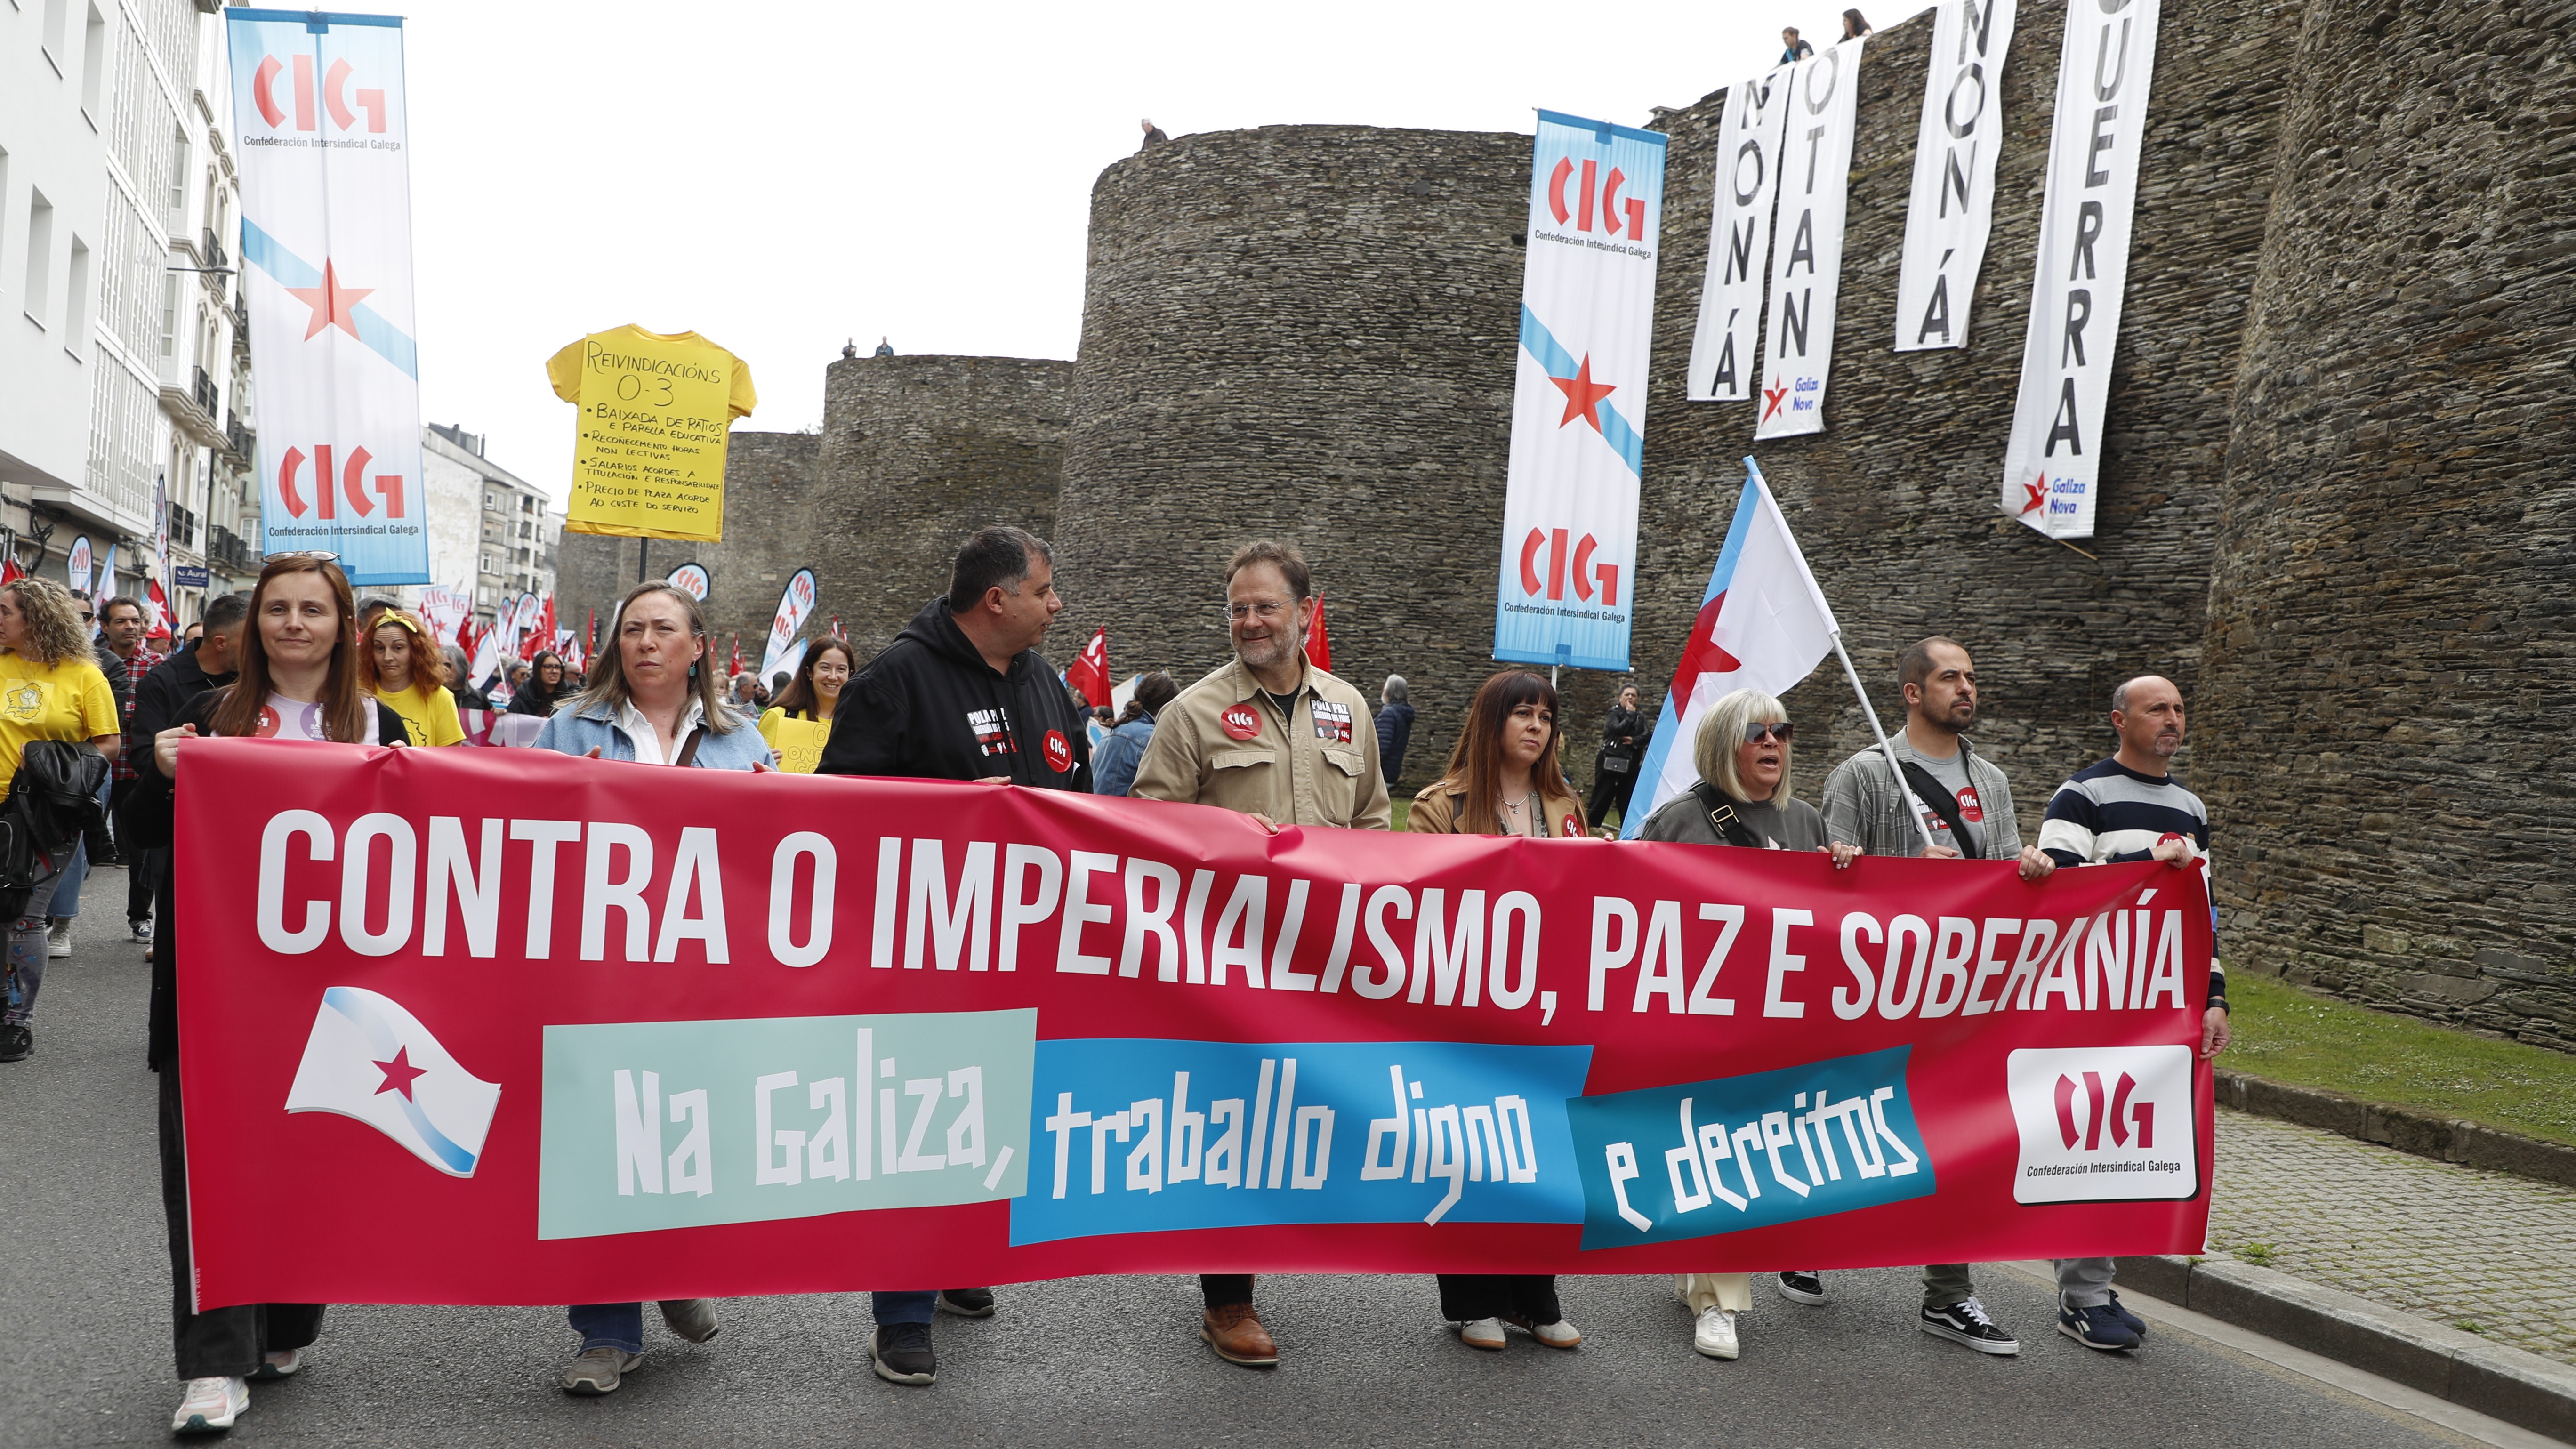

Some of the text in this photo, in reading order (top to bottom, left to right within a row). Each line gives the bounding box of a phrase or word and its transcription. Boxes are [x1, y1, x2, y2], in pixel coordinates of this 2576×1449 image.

[254, 54, 386, 133] CIG
[1939, 0, 1994, 219] NON
[244, 136, 400, 151] Confederación Intersindical Galega
[1724, 73, 1777, 285] NON
[1549, 156, 1645, 242] CIG
[1779, 47, 1839, 359] OTAN
[1535, 229, 1584, 246] Confederación
[1628, 246, 1651, 260] Galega
[1917, 249, 1955, 344] Á
[587, 341, 720, 384] REIVINDICACIÓNS
[1711, 308, 1740, 396] Á
[1795, 377, 1818, 392] Galiza
[1793, 396, 1813, 411] Nova
[596, 403, 723, 436] BAIXADA DE RATIOS
[591, 430, 701, 454] RECOÑECEMENTO HORAS
[622, 422, 666, 435] PARELLA
[670, 430, 721, 445] EDUCATIVA
[596, 446, 671, 460] NON LECTIVAS
[584, 468, 638, 481] TITULACIÓN
[589, 457, 637, 471] SALARIOS
[642, 465, 680, 476] ACORDES
[279, 445, 405, 520] CIG
[585, 481, 710, 503] PRECIO DE PLAZA ACORDE
[2053, 477, 2085, 494] Galiza
[589, 498, 604, 507] AO
[610, 499, 639, 508] CUSTE
[646, 502, 658, 510] DO
[2049, 497, 2077, 514] Nova
[269, 525, 419, 536] Confederación Intersindical Galega
[187, 569, 207, 578] Aural
[1520, 527, 1618, 606] CIG
[678, 569, 703, 595] CIG
[796, 575, 812, 605] CIG
[425, 590, 448, 604] CIG
[452, 598, 465, 611] IG
[1505, 602, 1625, 624] Confederación Intersindical Galega
[775, 614, 791, 641] CIG
[967, 710, 991, 725] POLA
[1311, 699, 1349, 715] POLA PAZ
[1228, 712, 1253, 725] CIG
[1341, 730, 1349, 739] CIG
[1050, 737, 1066, 757] CIG
[1960, 795, 1978, 807] CIG
[257, 809, 2186, 1026] CONTRA O IMPERIALISMO, PAZ E SOBERANÍA
[2054, 1071, 2155, 1151] CIG
[614, 1028, 1919, 1233] Na Galiza, traballo digno e dereitos
[2027, 1160, 2181, 1177] Confederación Intersindical Galega
